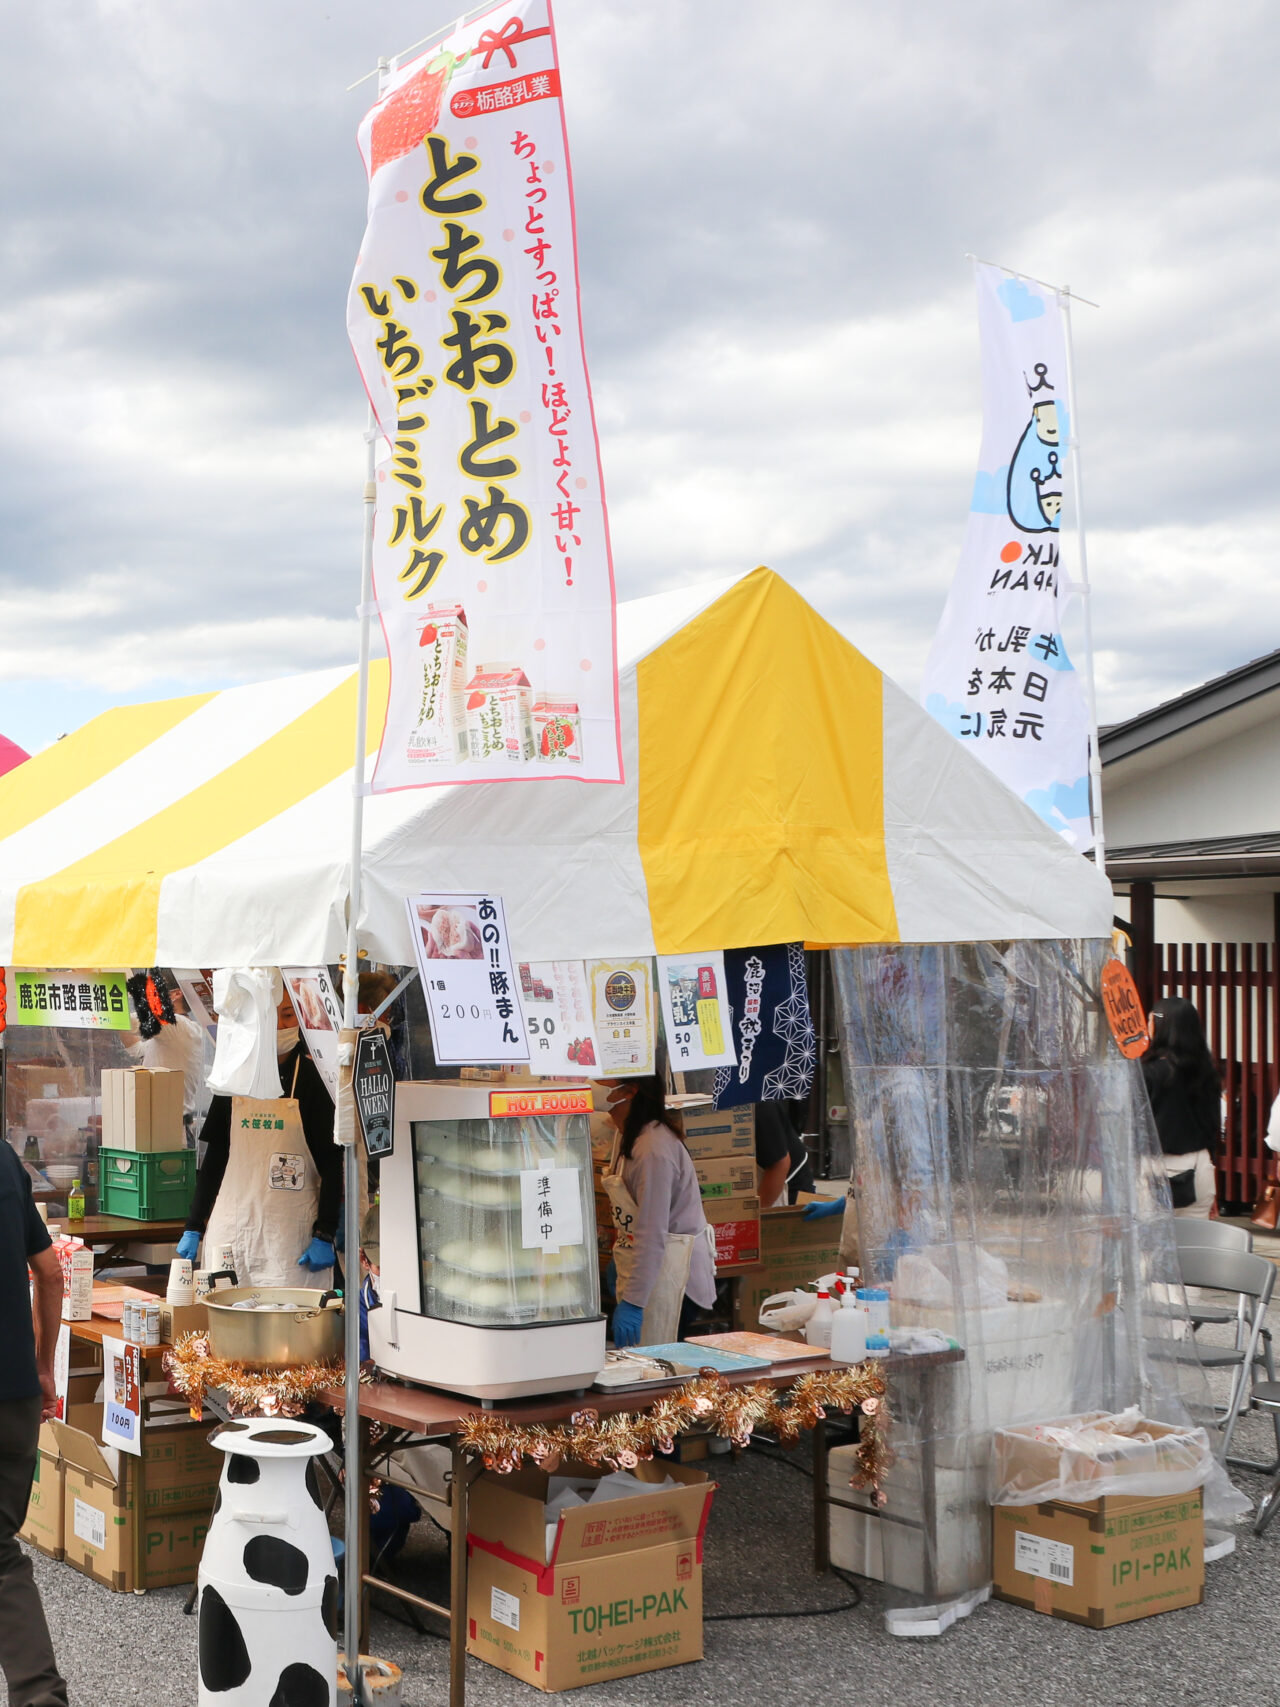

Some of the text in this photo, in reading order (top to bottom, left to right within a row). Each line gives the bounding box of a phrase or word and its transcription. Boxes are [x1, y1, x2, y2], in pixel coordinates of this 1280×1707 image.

[476, 74, 551, 111] 栃酪乳業
[421, 135, 531, 563] とちおとめ
[361, 277, 447, 600] いちごミルク
[19, 982, 124, 1013] 鹿沼市酪農組合
[528, 1017, 556, 1035] 50
[539, 1038, 550, 1050] 円
[360, 1074, 389, 1097] HALLO
[362, 1094, 389, 1117] WEEN
[507, 1093, 587, 1112] HOT FOODS
[241, 1118, 284, 1130] 大笹牧場
[537, 1176, 553, 1240] 準備中
[111, 1412, 131, 1430] 100円
[1112, 1546, 1192, 1587] IPI-PAK
[568, 1586, 689, 1636] TOHEI-PAK
